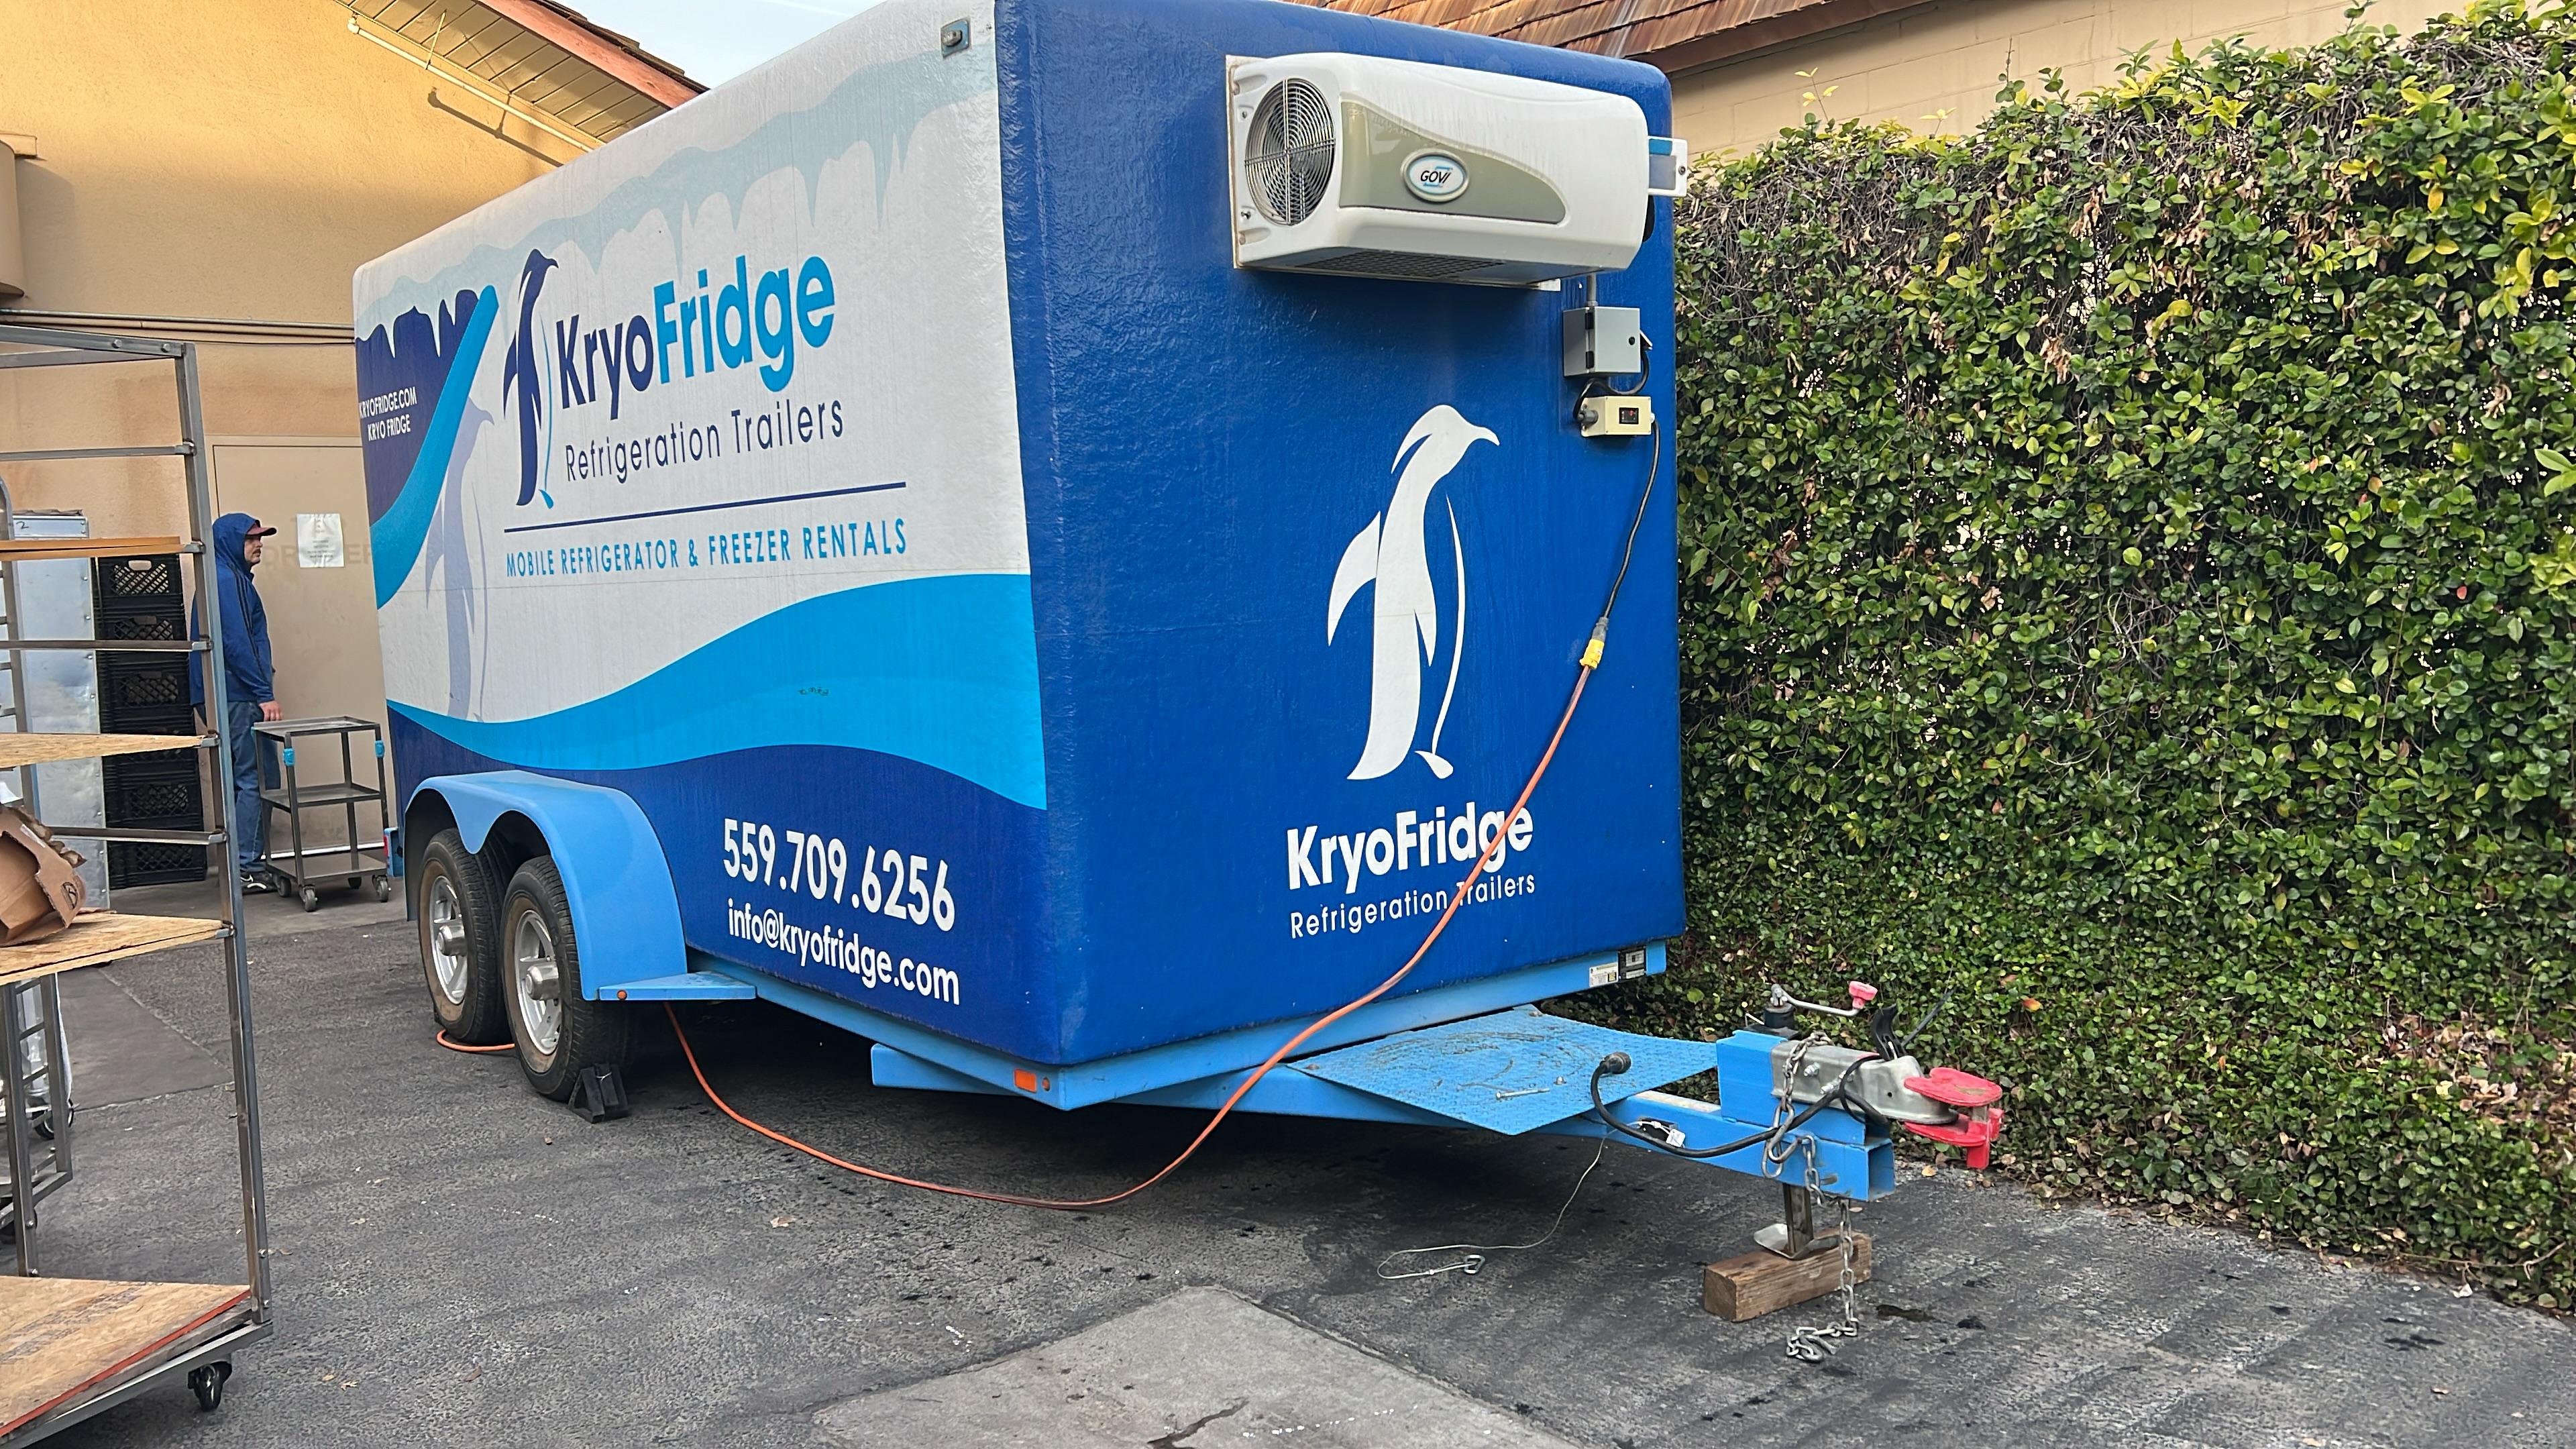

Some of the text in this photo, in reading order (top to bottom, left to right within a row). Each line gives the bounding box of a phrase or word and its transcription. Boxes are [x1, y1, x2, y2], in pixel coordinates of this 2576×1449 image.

[1420, 170, 1452, 184] GOVI
[556, 255, 835, 421] KryoFridge
[358, 386, 417, 419] KRYOFRIDGE.COM
[368, 414, 411, 441] KRYO FRIDGE
[566, 398, 844, 484] Refrigeration Trailers
[506, 518, 906, 578] MOBILE REFRIGERATOR & FREEZER RENTALS
[723, 818, 955, 932] 559.709.6256
[1287, 802, 1534, 894] KryoFridge
[1291, 889, 1448, 939] Refrigeration
[728, 898, 961, 1006] info@kryofridge.com
